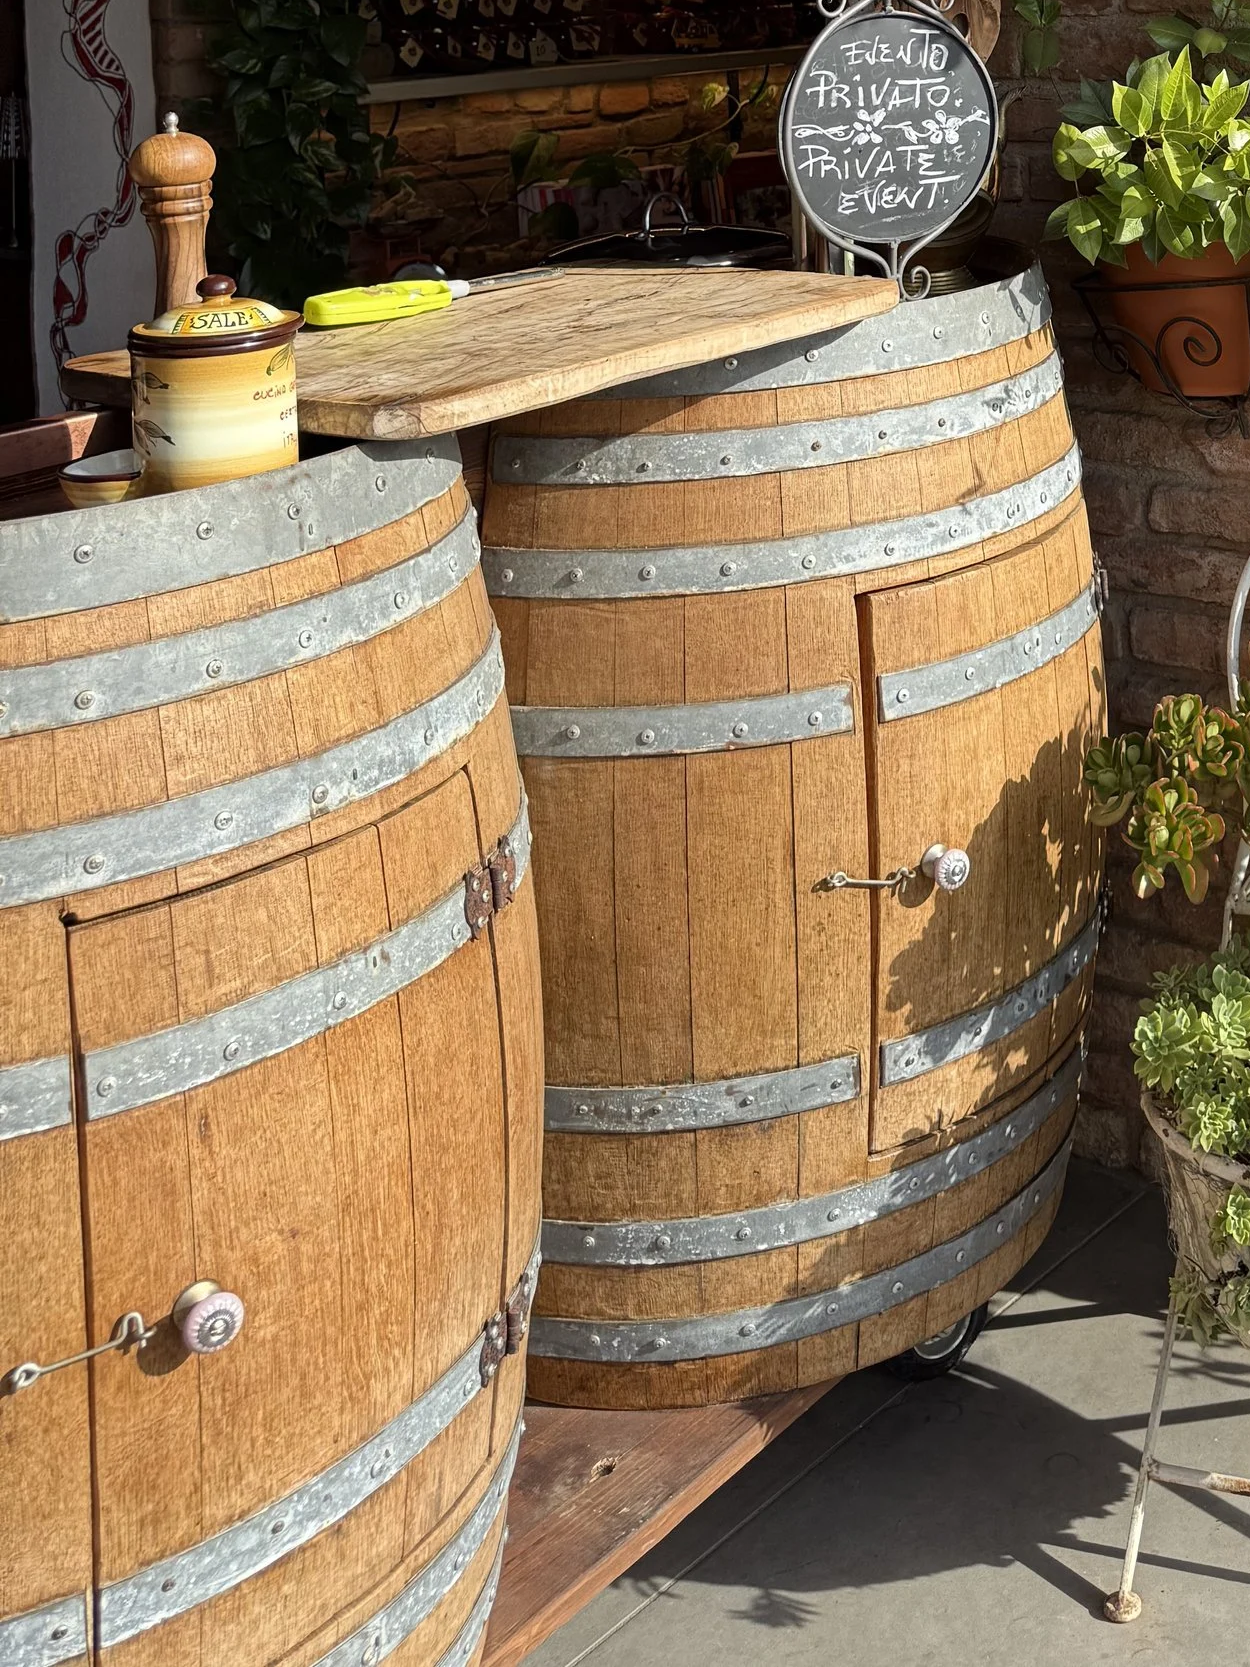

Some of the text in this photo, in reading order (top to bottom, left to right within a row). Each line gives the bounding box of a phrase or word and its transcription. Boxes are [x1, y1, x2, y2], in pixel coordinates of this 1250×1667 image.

[840, 28, 949, 71] EVENTO
[798, 144, 947, 180] PRIVATE
[189, 311, 249, 329] SALE
